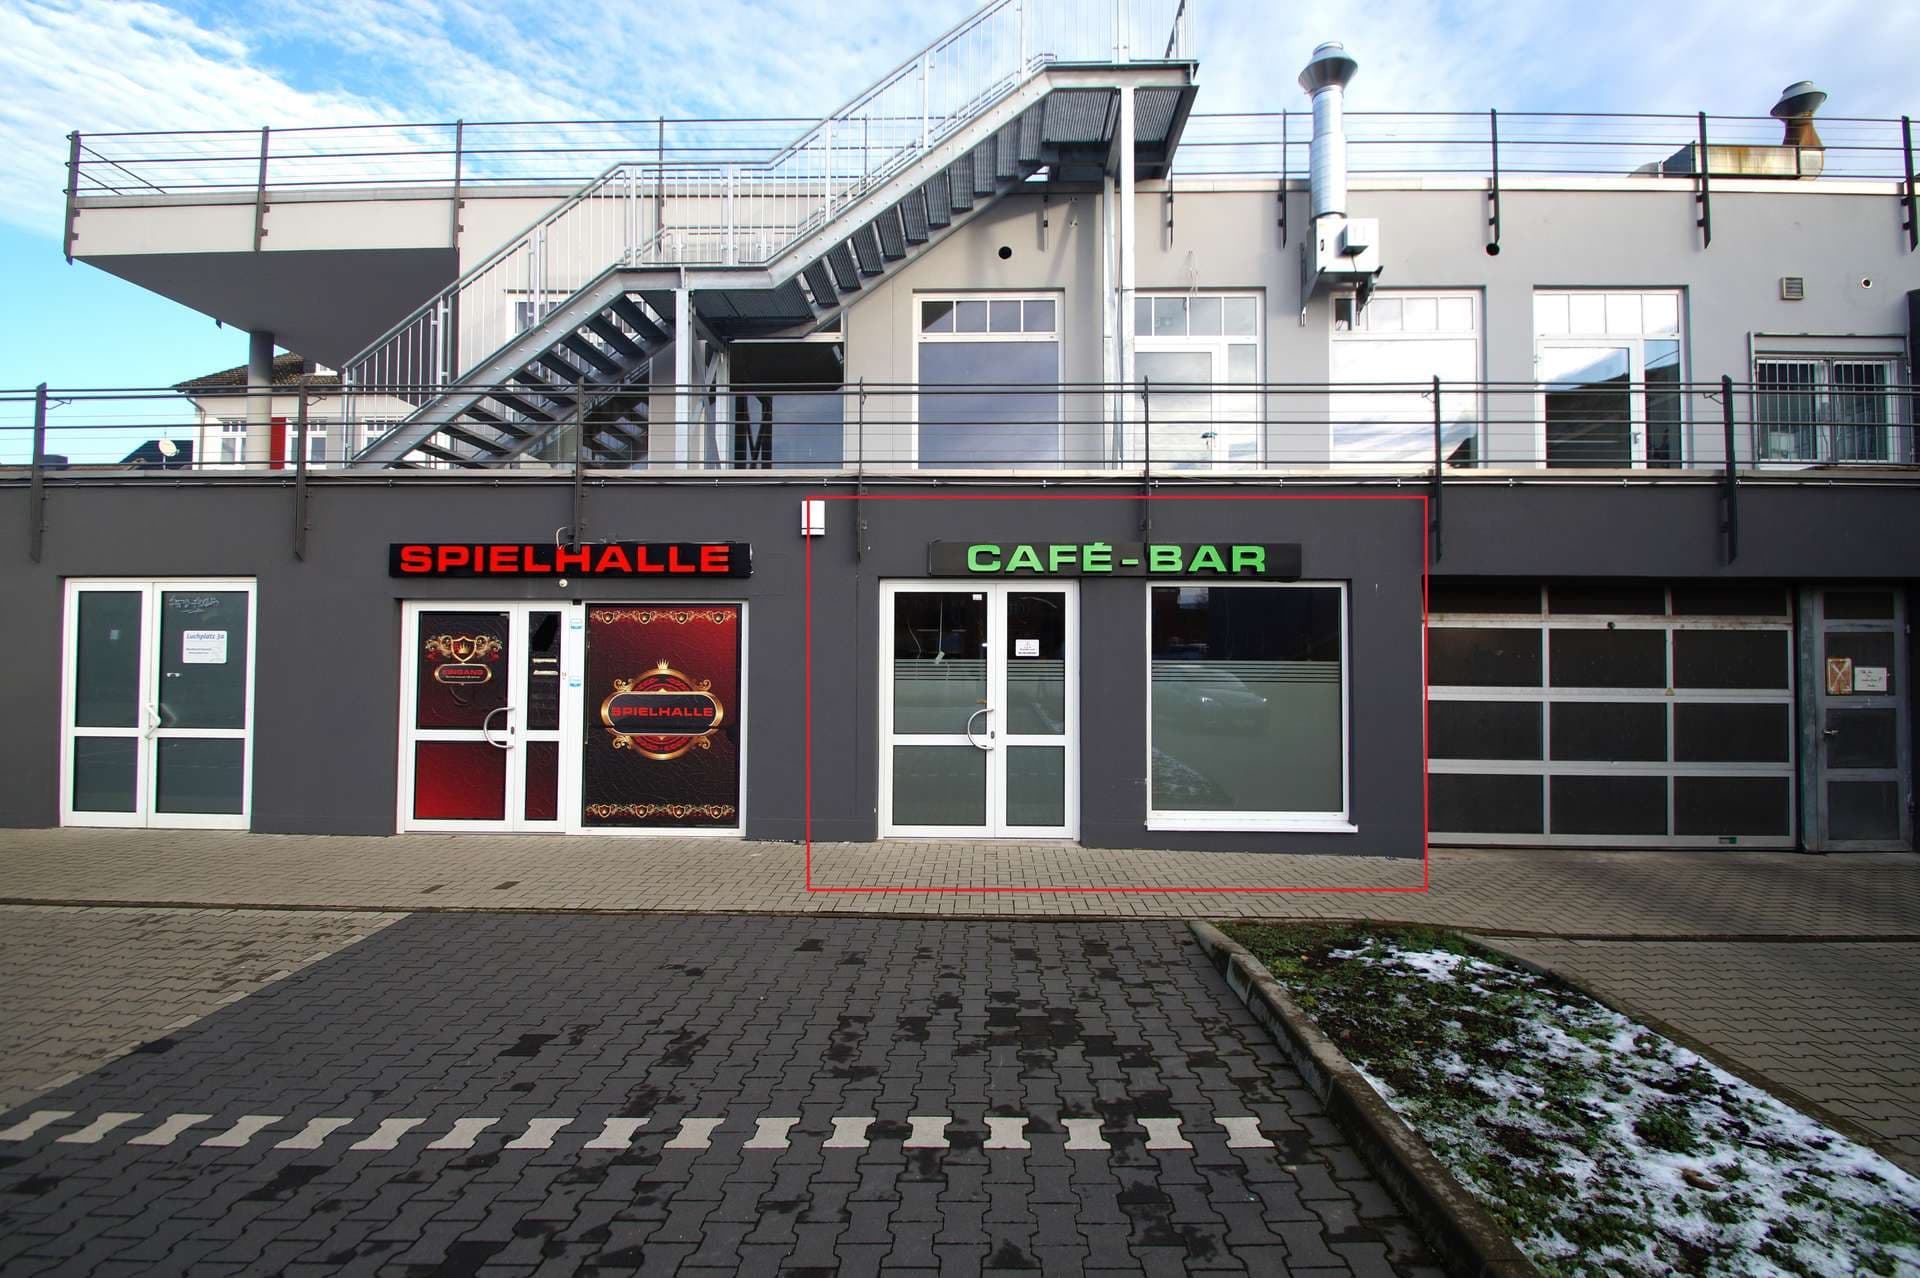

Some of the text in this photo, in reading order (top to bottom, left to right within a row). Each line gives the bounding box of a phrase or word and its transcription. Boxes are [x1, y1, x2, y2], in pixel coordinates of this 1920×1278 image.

[400, 545, 730, 573] SPIELHALLE
[967, 542, 1266, 573] CAFÉ-BAR
[611, 706, 713, 718] SPIELHALLE
